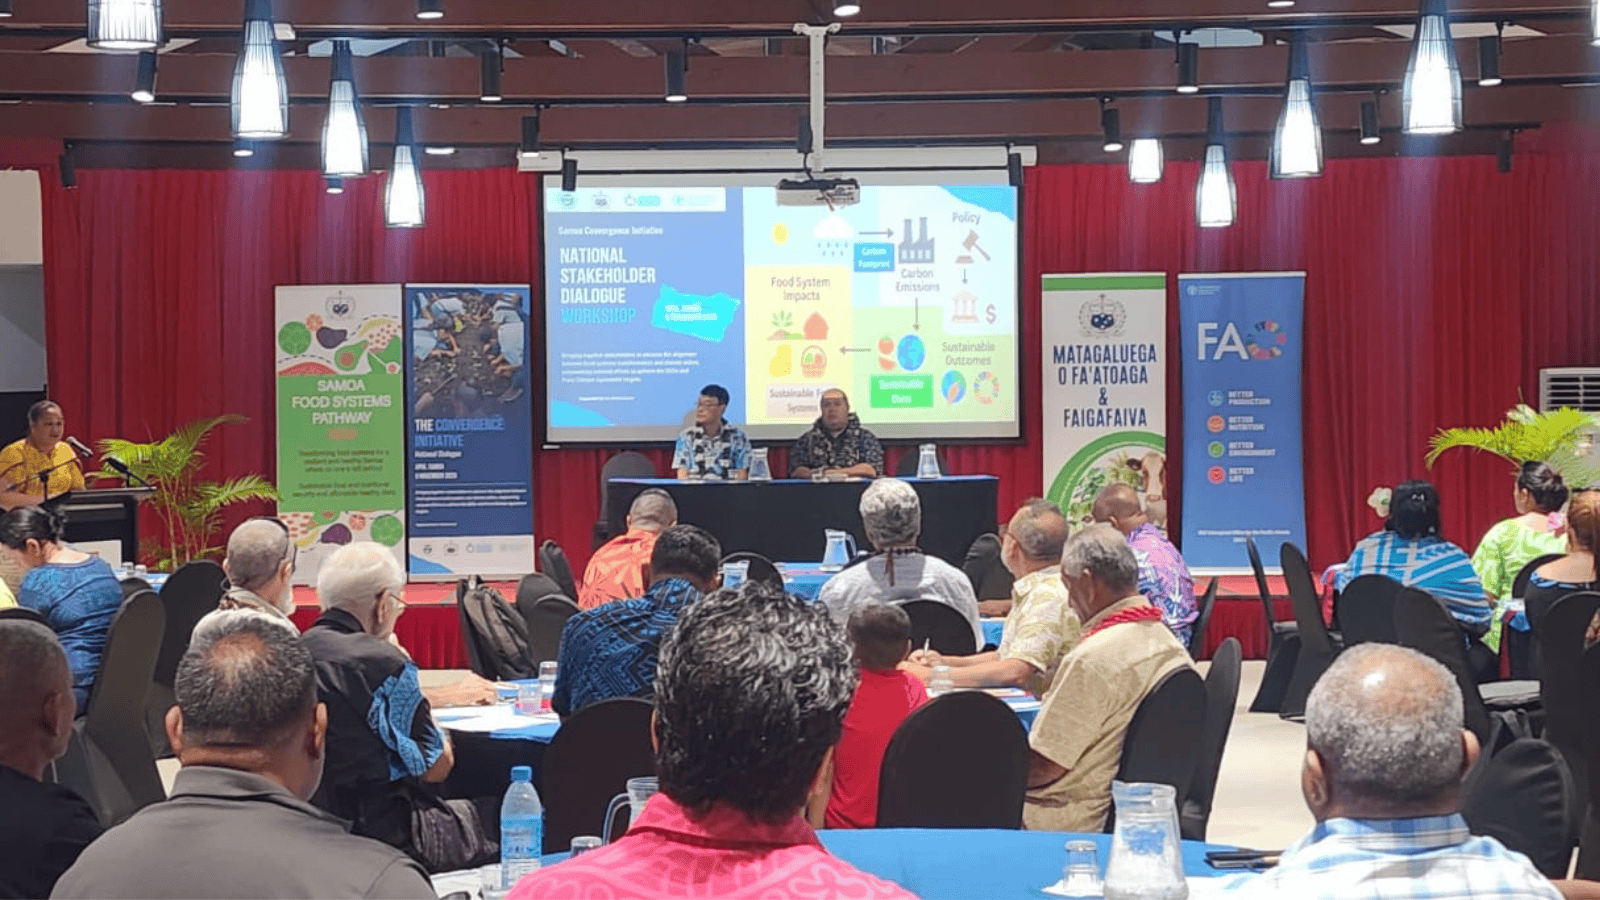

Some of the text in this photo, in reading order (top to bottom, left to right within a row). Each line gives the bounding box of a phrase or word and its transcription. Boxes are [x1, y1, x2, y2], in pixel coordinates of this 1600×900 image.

[952, 212, 981, 225] Policy
[559, 247, 627, 264] NATIONAL
[560, 267, 656, 284] STAKEHOLDER
[900, 268, 934, 279] Carbon
[771, 276, 831, 291] Food System
[895, 281, 940, 292] Emissions
[560, 287, 627, 304] DIALOGUE
[783, 290, 821, 303] Impacts
[560, 307, 637, 324] WORKSHOP
[942, 341, 996, 352] Sustainable
[1053, 343, 1157, 364] MATAGALUEGA
[945, 355, 992, 366] Outcomes
[1058, 365, 1148, 385] O FA'ATOAGA
[317, 379, 366, 392] SAMOA
[292, 395, 392, 409] FOOD SYSTEMS
[1098, 387, 1108, 406] &
[312, 411, 373, 425] PATHWAY
[1063, 407, 1147, 428] FAIGAFAIVA
[414, 418, 434, 432] THE
[414, 434, 464, 447] INITIATIVE
